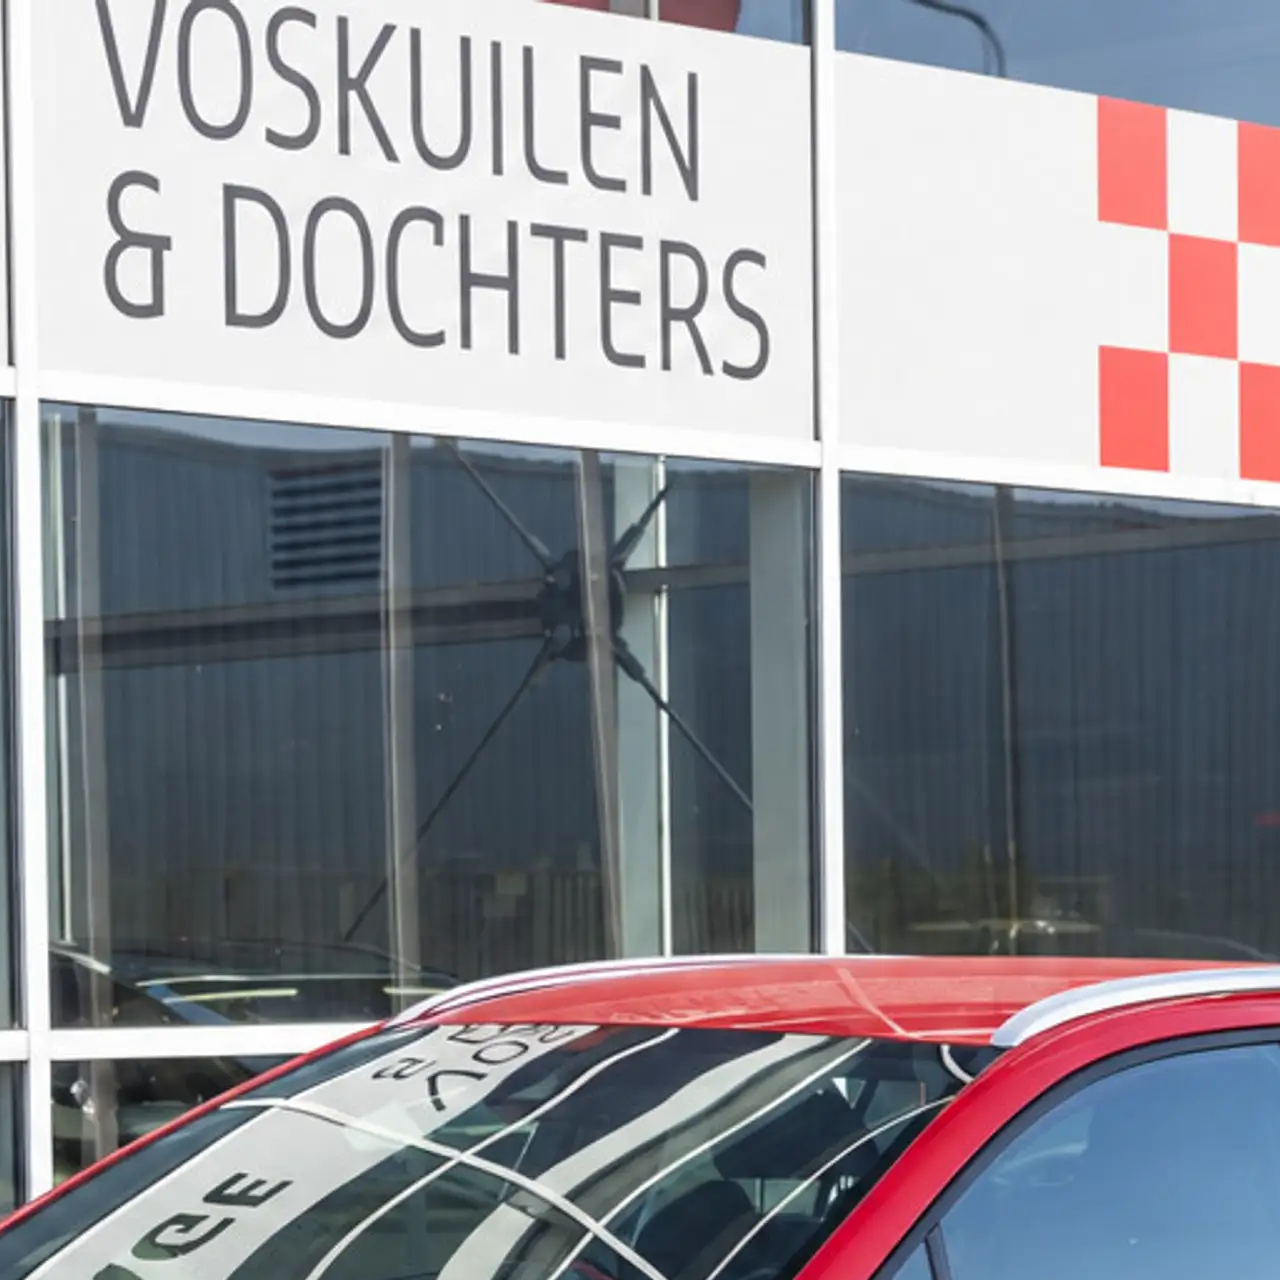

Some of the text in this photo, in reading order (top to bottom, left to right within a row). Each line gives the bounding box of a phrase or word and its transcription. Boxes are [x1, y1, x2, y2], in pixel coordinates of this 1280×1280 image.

[94, 0, 699, 202] VOSKUILEN
[103, 170, 770, 381] & DOCHTERS
